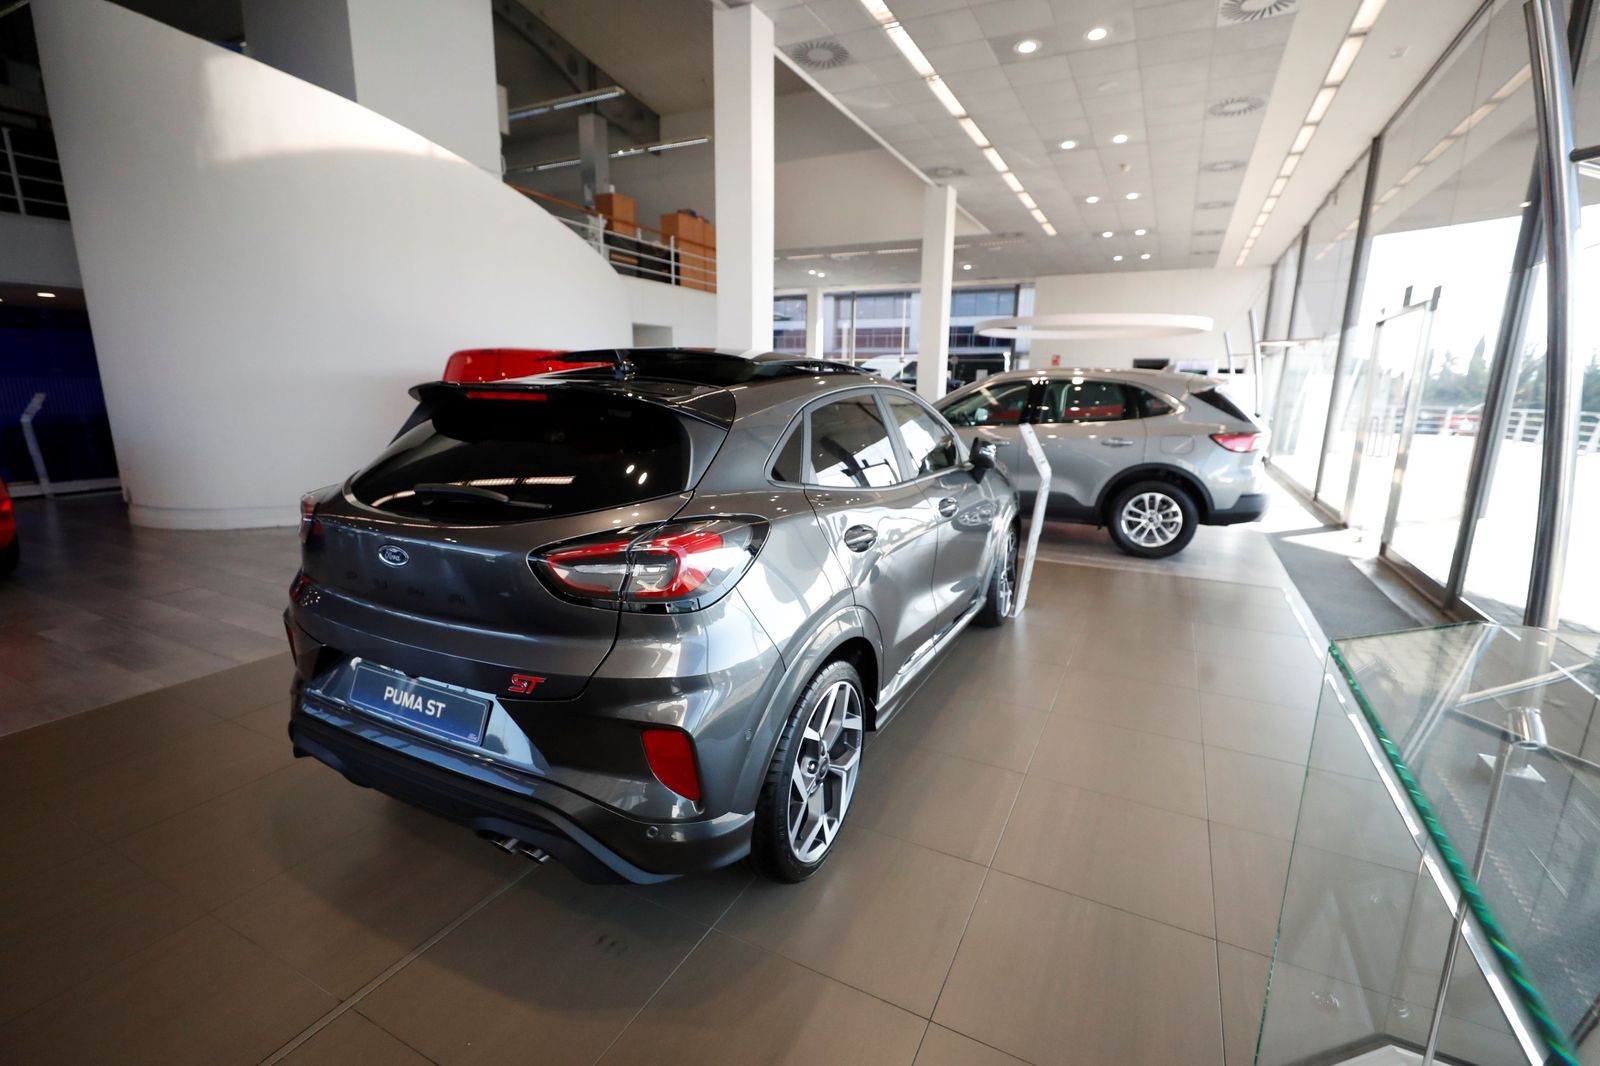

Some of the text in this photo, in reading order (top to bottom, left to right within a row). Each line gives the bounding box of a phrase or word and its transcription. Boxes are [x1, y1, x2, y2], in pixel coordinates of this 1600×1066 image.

[508, 674, 546, 694] ST
[384, 686, 446, 718] PUMA ST
